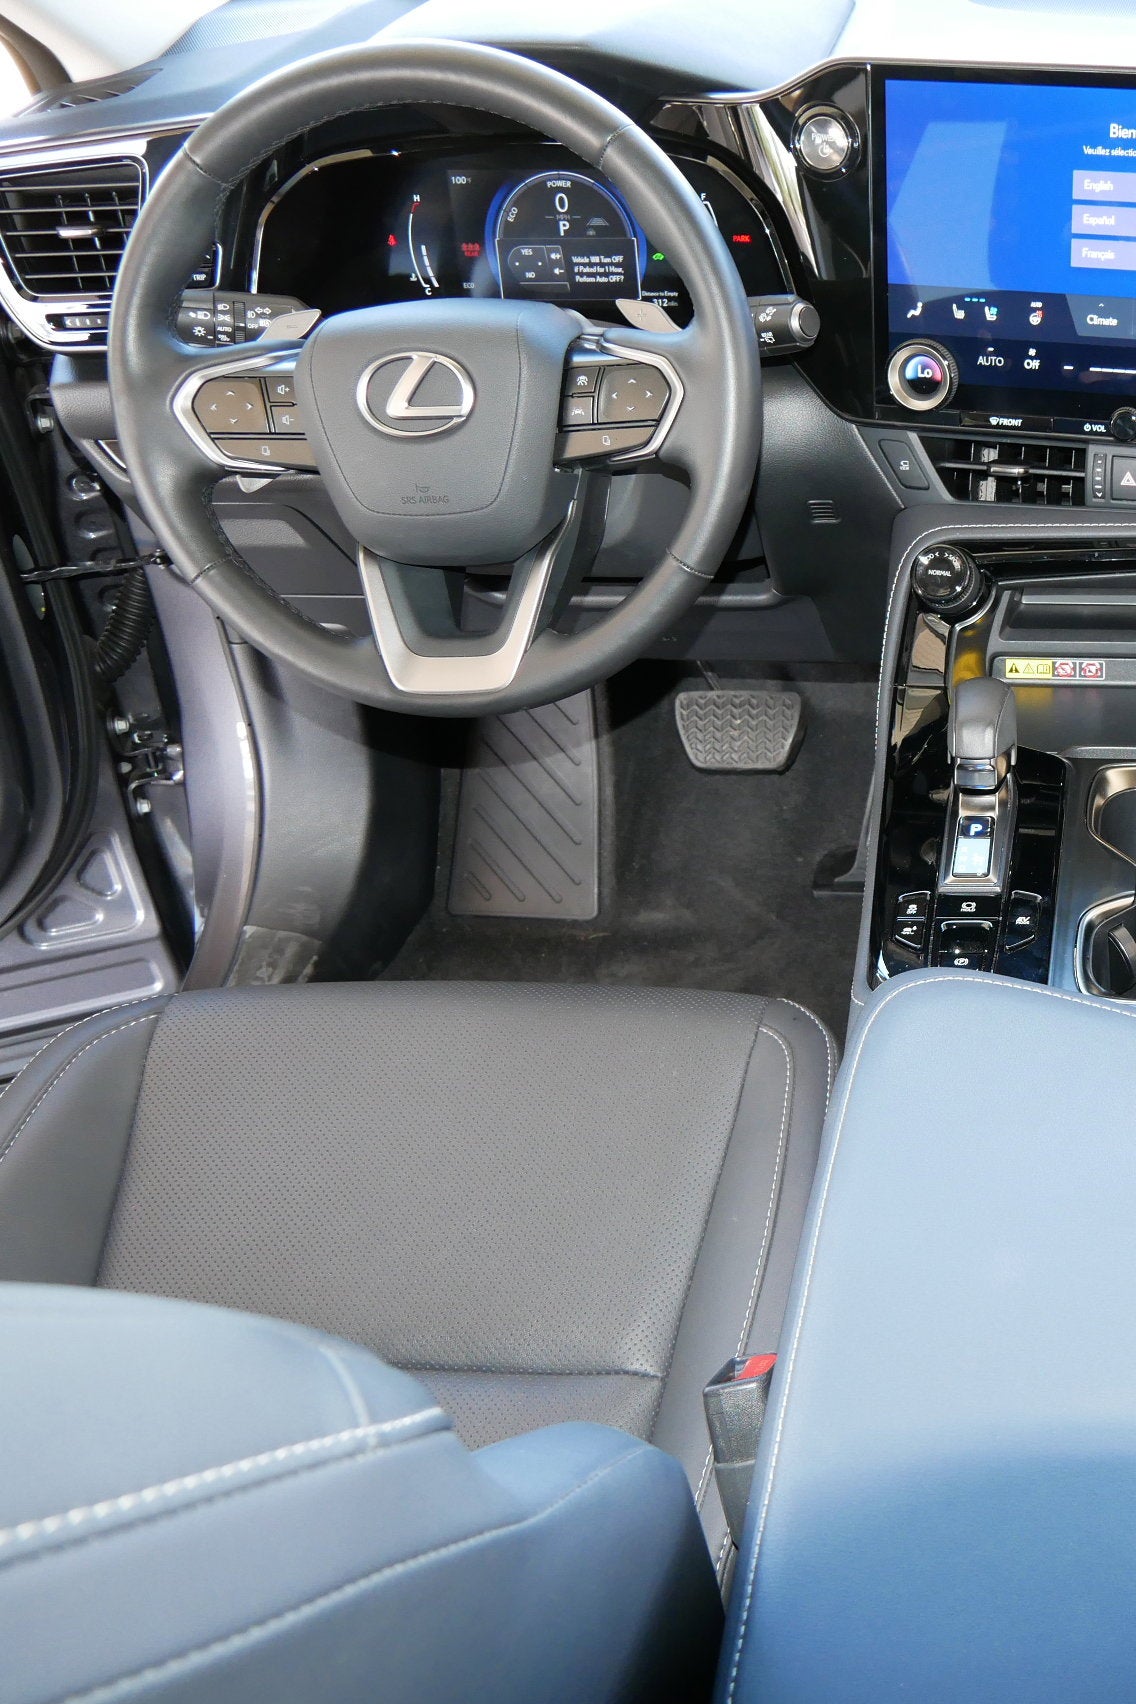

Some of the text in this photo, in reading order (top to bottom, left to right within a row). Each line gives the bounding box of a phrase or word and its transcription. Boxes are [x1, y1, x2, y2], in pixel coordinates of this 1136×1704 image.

[1083, 145, 1110, 156] Veuillez
[546, 180, 572, 188] POWER
[1084, 180, 1114, 193] English
[413, 194, 421, 202] H
[555, 193, 568, 213] 0
[507, 206, 519, 223] ECO
[1083, 213, 1116, 227] Español
[559, 221, 570, 237] P
[732, 235, 751, 243] PARK
[1082, 247, 1116, 262] Français
[425, 288, 432, 296] C
[1086, 314, 1118, 327] Climate
[977, 356, 1005, 367] AUTO
[1023, 358, 1041, 371] Off
[917, 364, 933, 379] Lo
[999, 417, 1023, 427] FRONT
[1092, 424, 1107, 433] VOL
[401, 495, 450, 505] SRS AIRBAG
[928, 569, 952, 577] NORMAL
[969, 823, 983, 836] P
